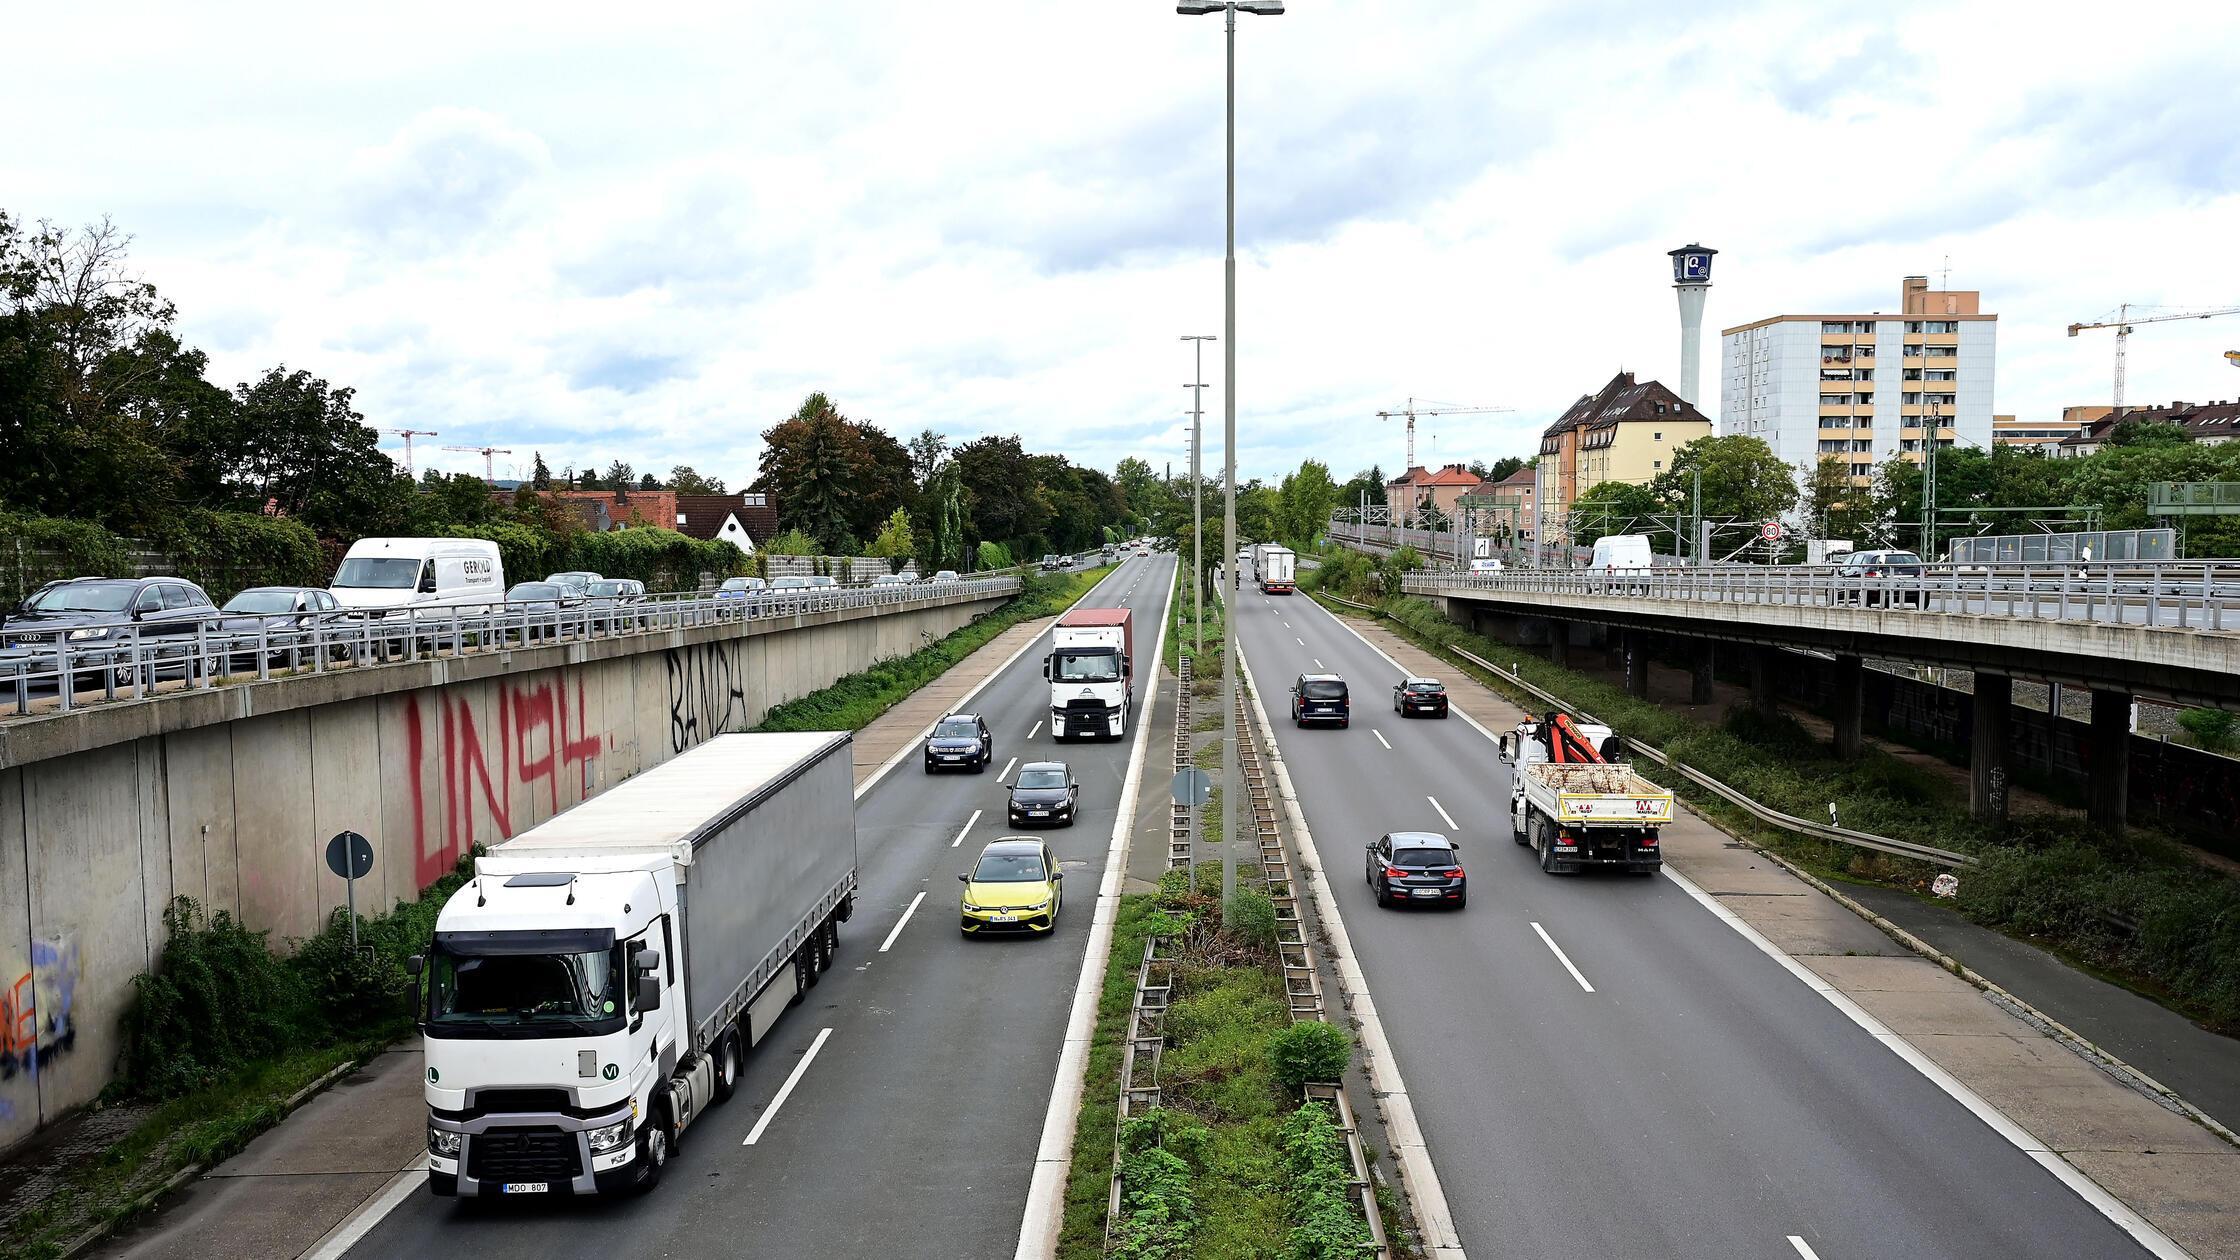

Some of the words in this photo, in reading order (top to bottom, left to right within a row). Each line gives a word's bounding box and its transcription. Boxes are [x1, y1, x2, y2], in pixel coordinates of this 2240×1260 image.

[1689, 256, 1699, 268] Q
[1766, 527, 1777, 535] 80
[464, 560, 491, 574] GEROLD
[429, 1068, 437, 1083] L
[605, 1065, 617, 1078] VI
[531, 1183, 546, 1192] 807
